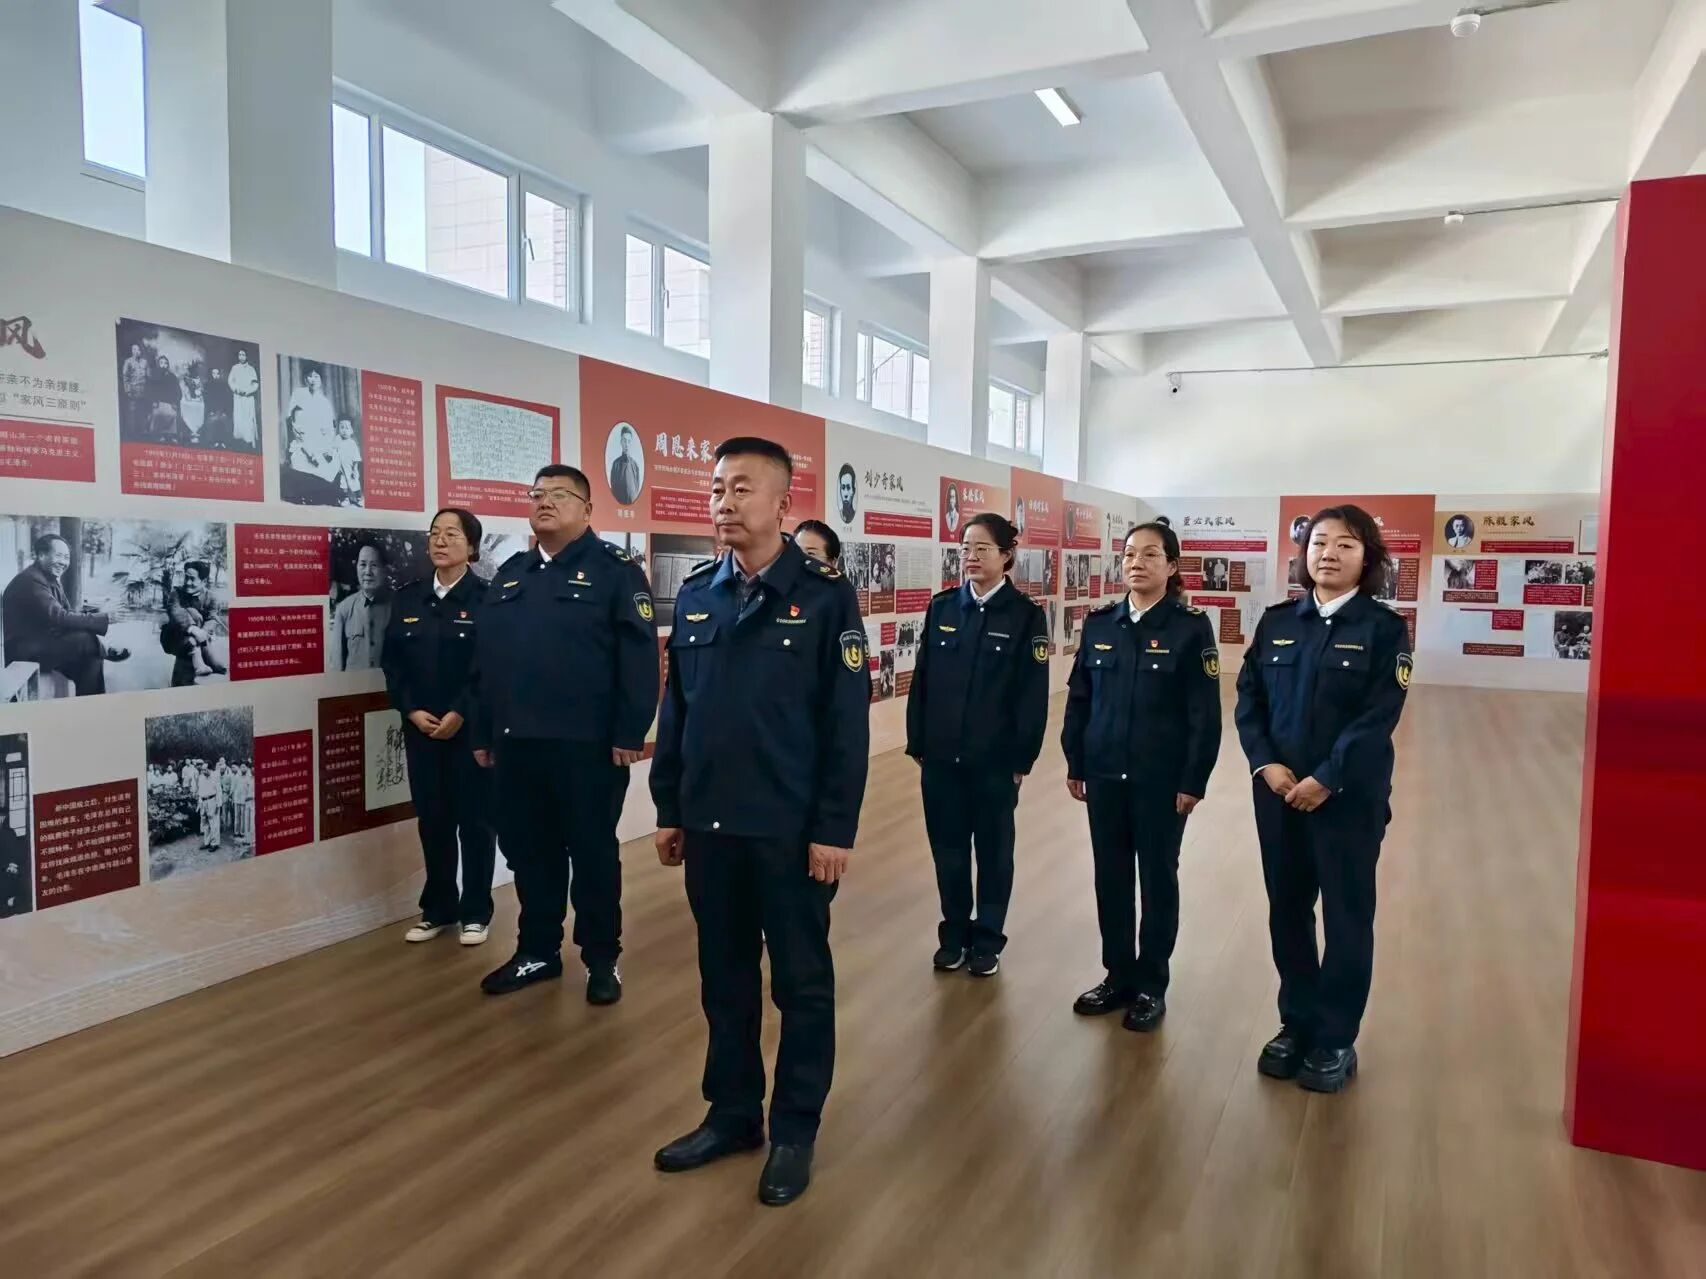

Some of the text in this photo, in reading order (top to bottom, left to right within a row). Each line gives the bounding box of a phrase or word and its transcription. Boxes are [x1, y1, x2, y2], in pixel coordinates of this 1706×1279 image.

[0, 316, 46, 359] 风
[655, 432, 717, 464] 周恩来家
[864, 469, 904, 492] 刘少奇家风
[1183, 516, 1235, 527] 董必武家风
[1483, 516, 1536, 527] 陈毅家风
